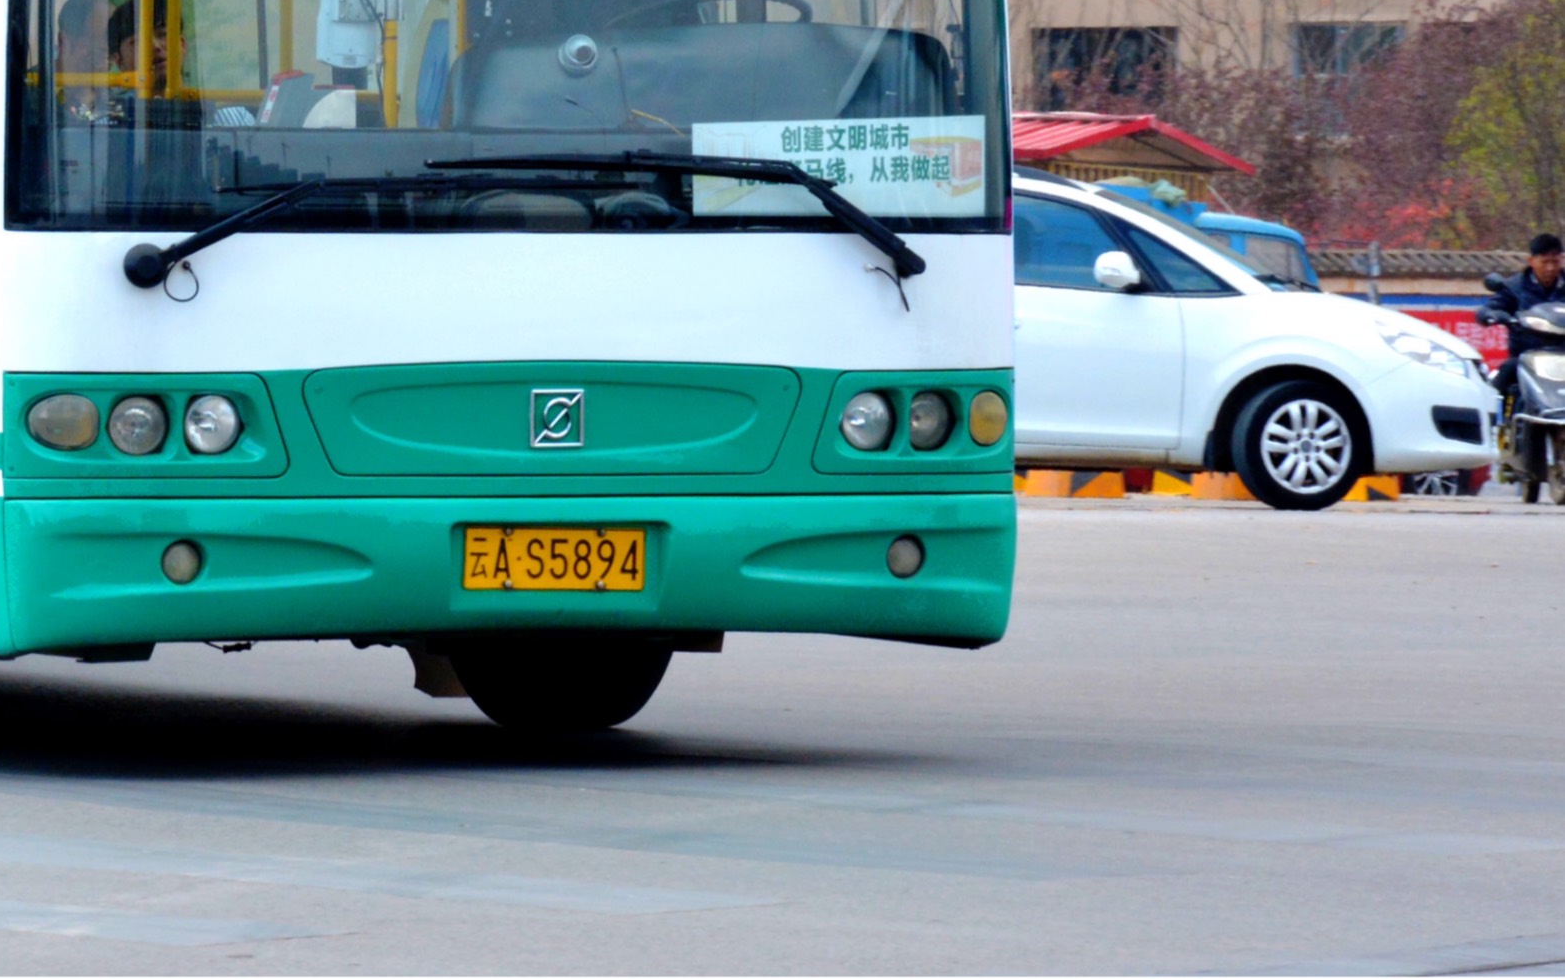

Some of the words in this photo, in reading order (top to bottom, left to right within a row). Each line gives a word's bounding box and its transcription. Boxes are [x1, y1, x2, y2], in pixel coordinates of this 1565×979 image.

[781, 124, 910, 153] 创建文明城市
